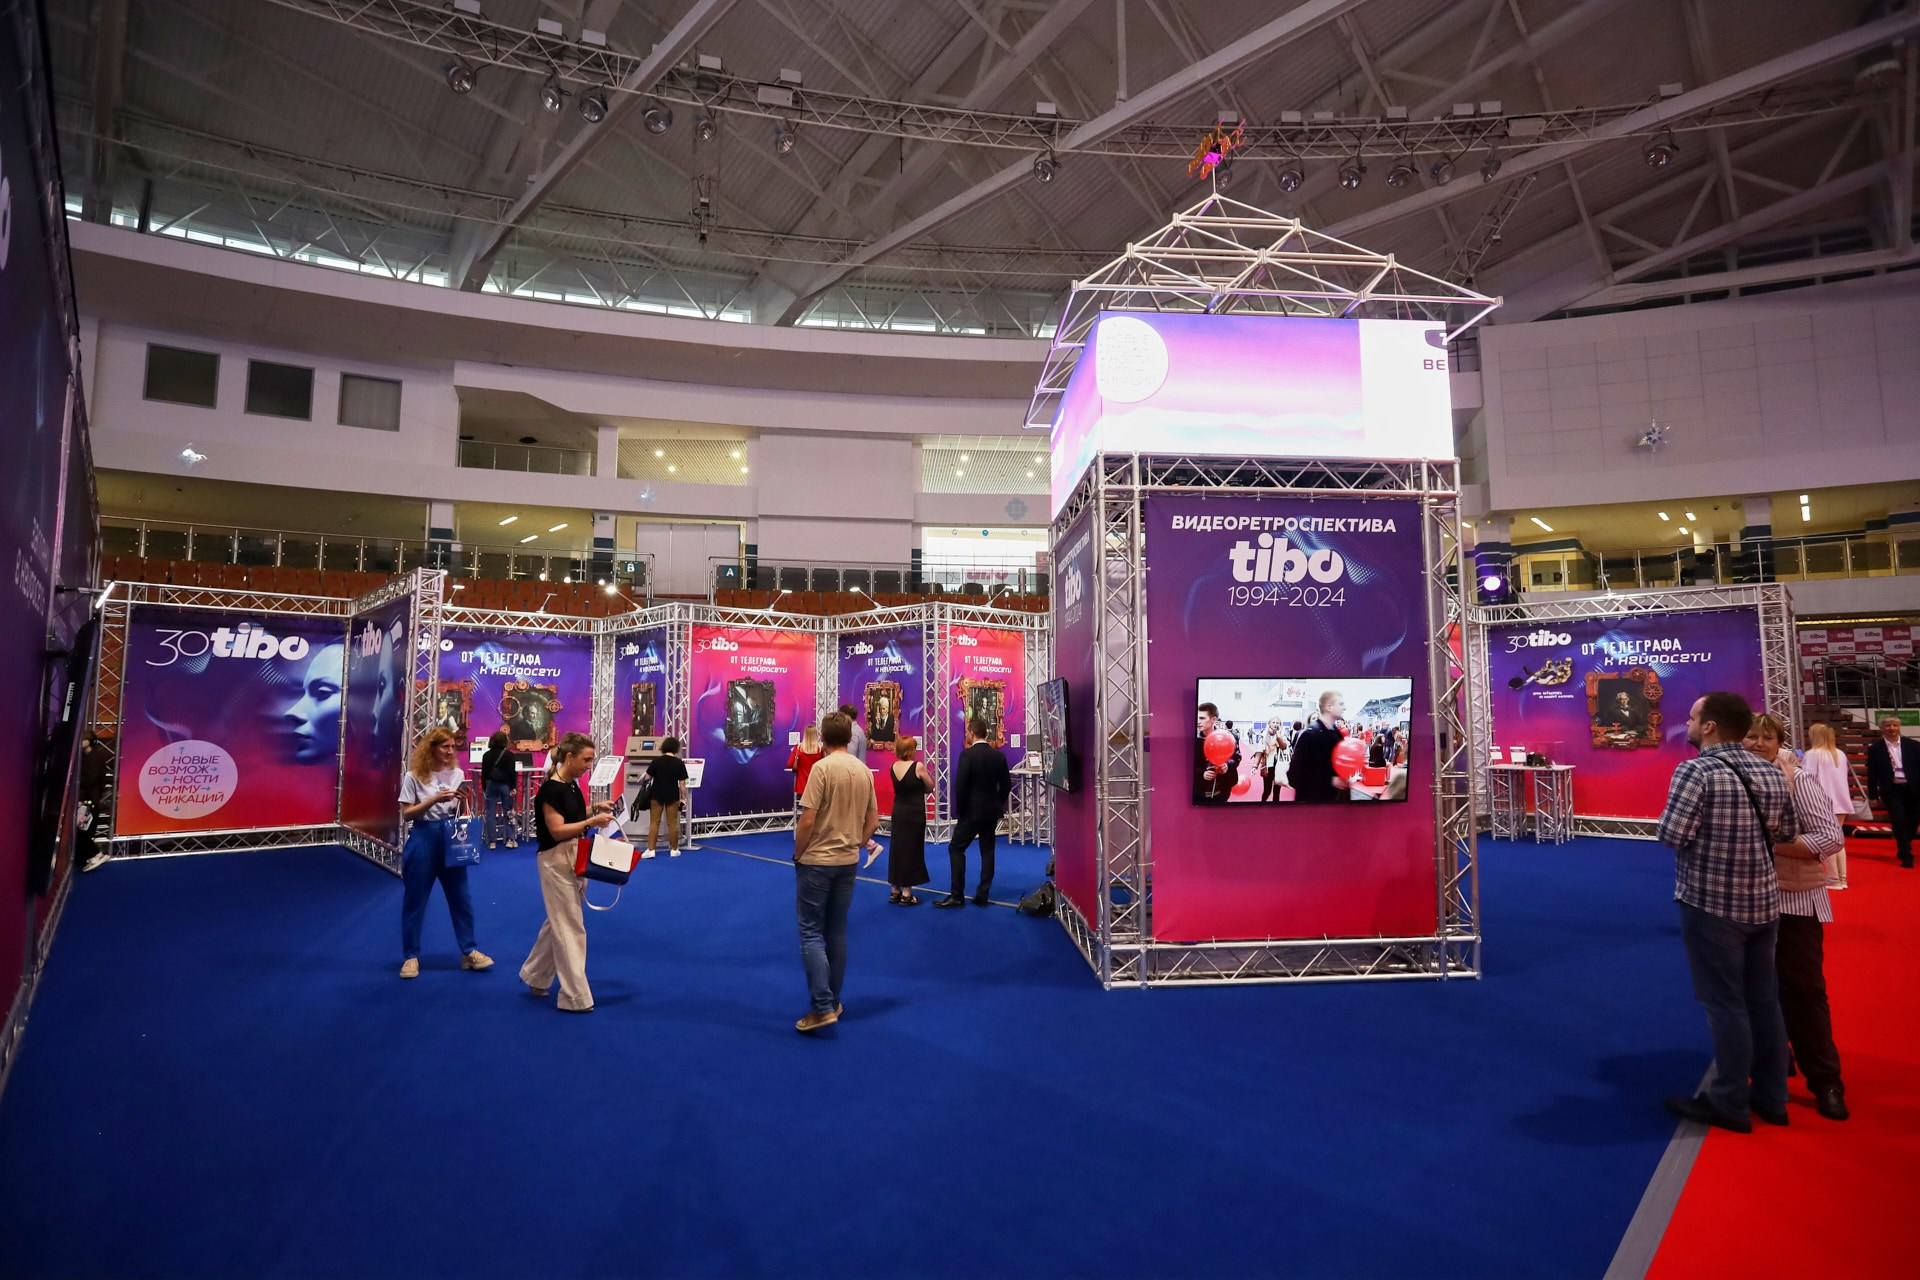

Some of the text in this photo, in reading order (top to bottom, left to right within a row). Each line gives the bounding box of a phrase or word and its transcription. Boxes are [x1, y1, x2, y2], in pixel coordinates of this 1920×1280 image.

[1171, 515, 1397, 534] ВИДЕОРЕТРОСПЕКТИВА
[1229, 533, 1345, 583] tibo
[626, 562, 635, 573] B
[726, 567, 735, 577] A
[1064, 566, 1082, 609] tibo
[1228, 586, 1347, 607] 1994-2024
[1581, 638, 1682, 656] ОТ ТЕЛЕГРАФА
[461, 651, 541, 666] ОТ ТЕЛЕГРАФА
[730, 656, 776, 666] ОТ ТЕЛЕГРАФА
[964, 655, 1003, 665] ОТ ТЕЛЕГРАФА
[171, 755, 220, 765] НОВЫЕ
[148, 765, 210, 776] ВОЗМОЖ
[173, 774, 219, 784] НОСТИ
[151, 785, 201, 795] КОММУ
[158, 791, 224, 805] НИКАЦИЙ
